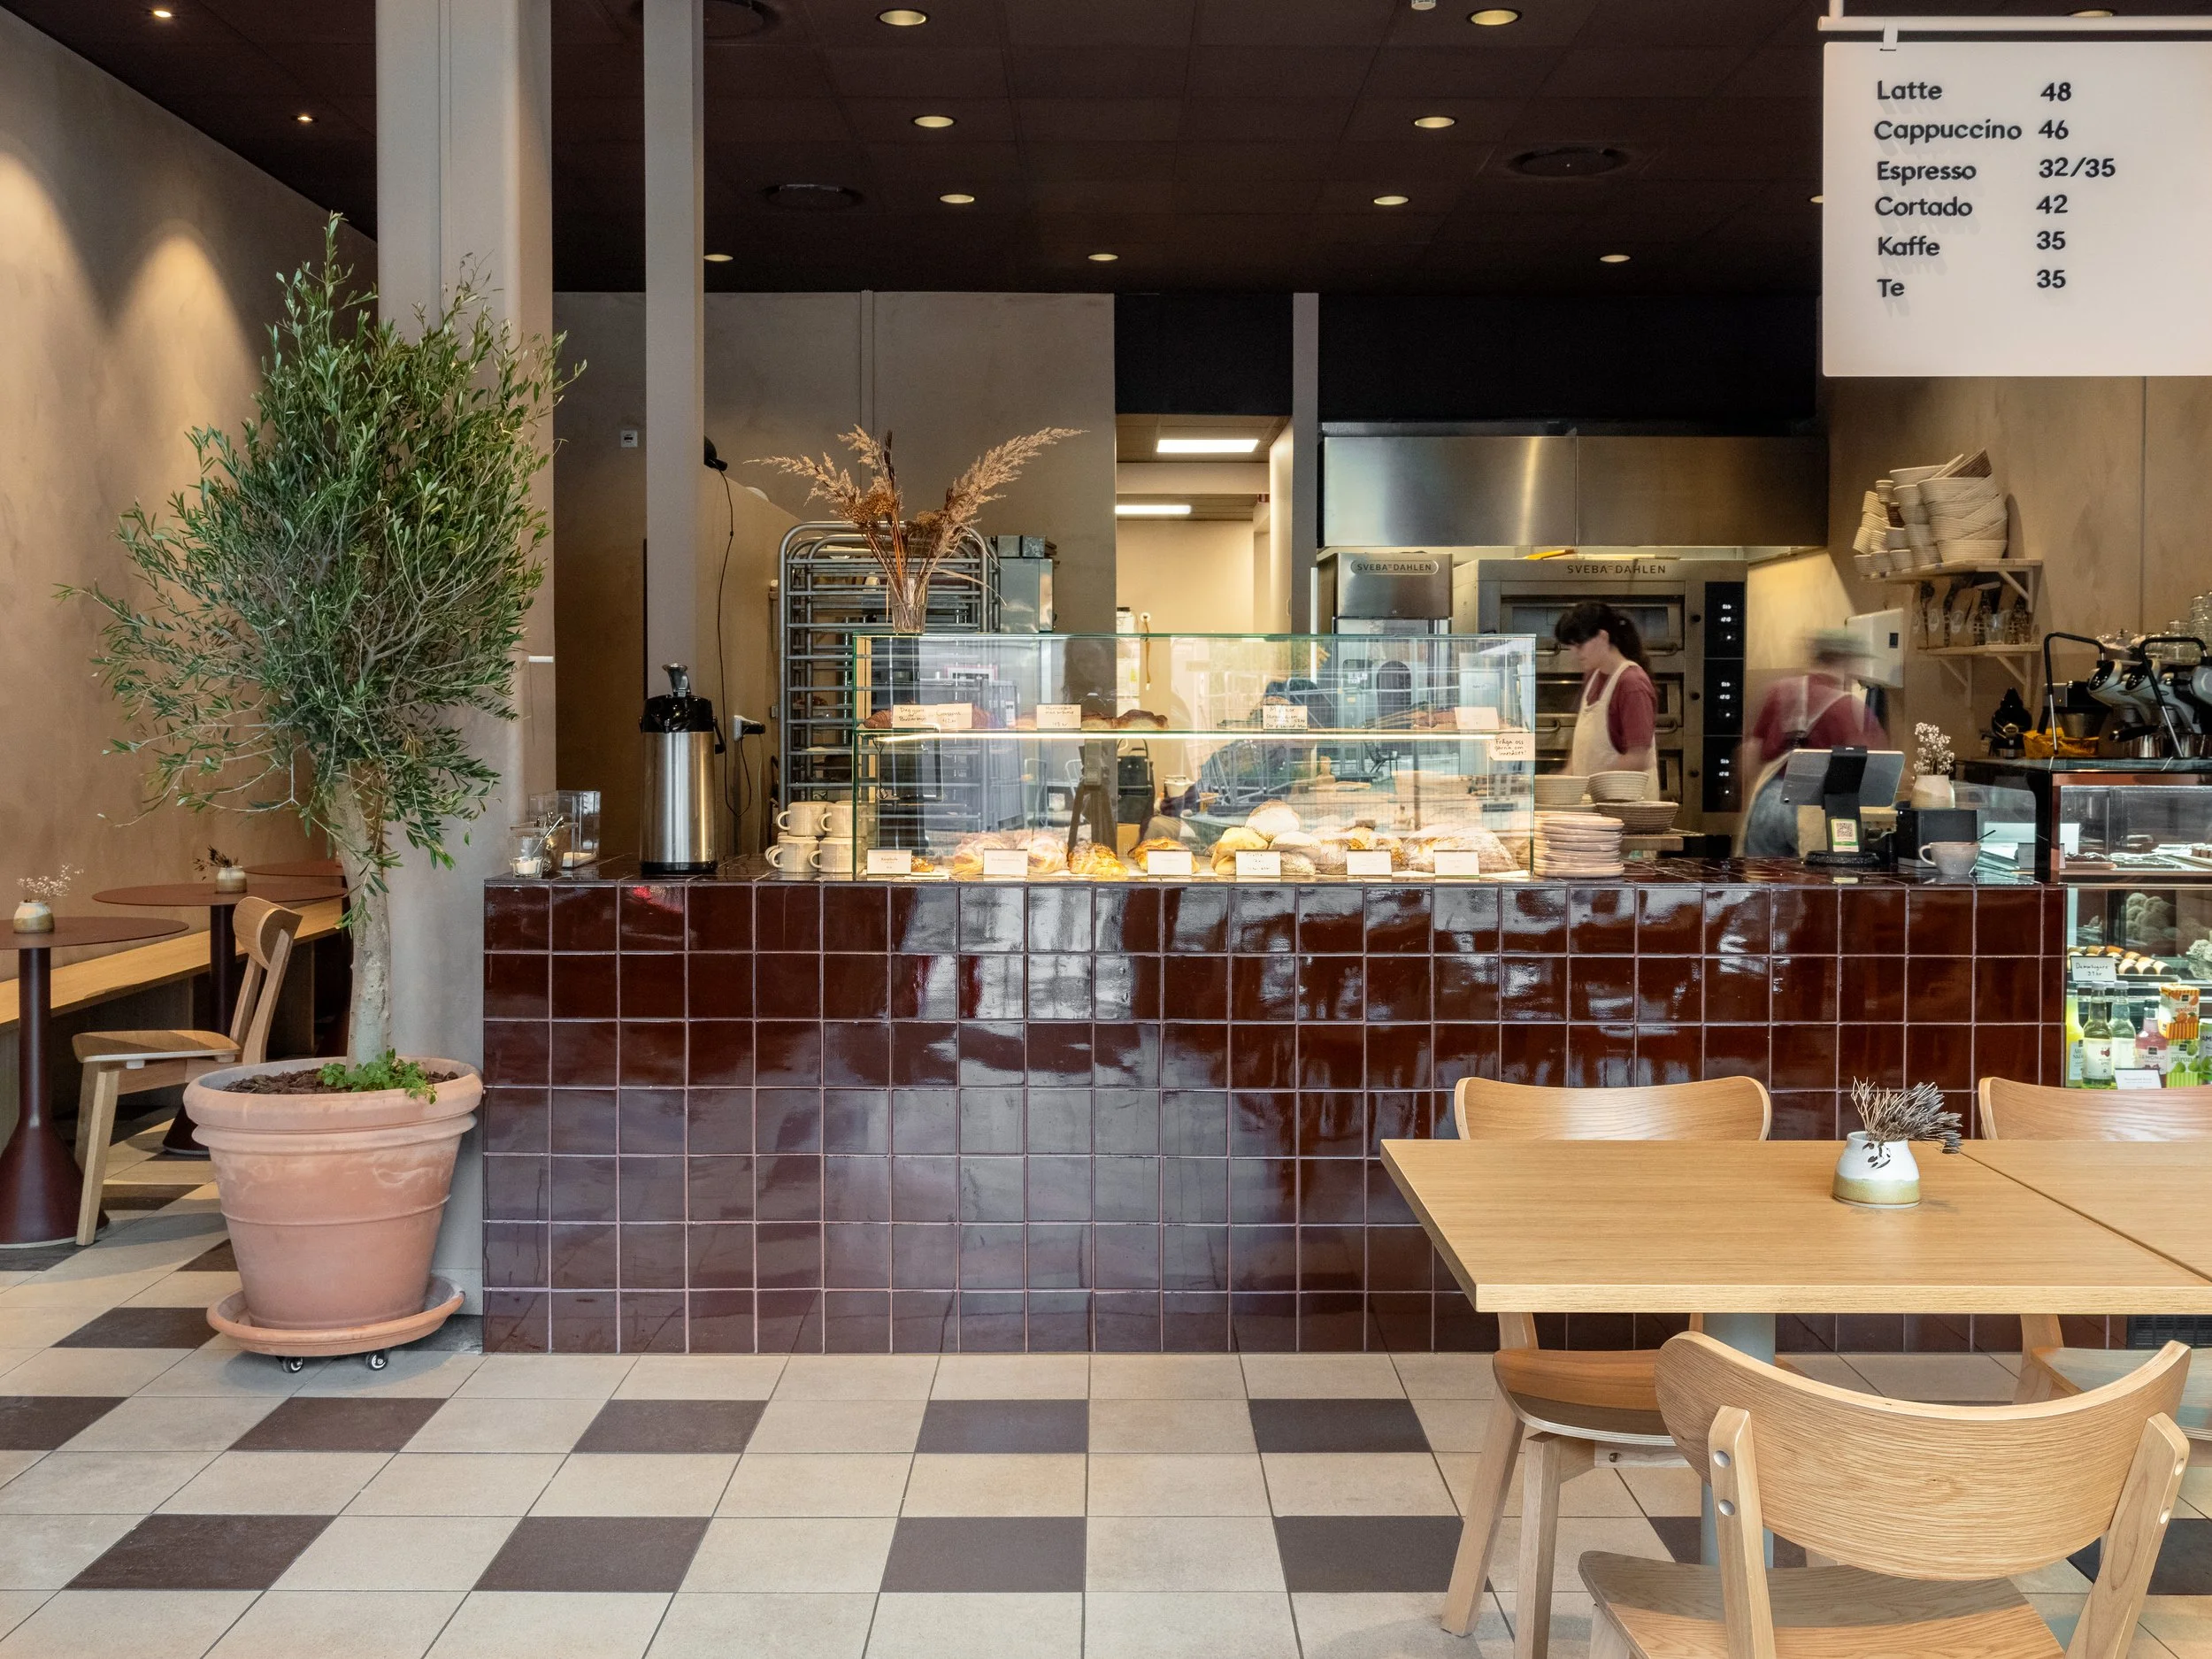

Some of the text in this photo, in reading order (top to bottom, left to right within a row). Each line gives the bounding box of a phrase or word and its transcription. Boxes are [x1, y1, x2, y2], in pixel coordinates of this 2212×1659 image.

[1878, 81, 2072, 102] Latte 48
[1874, 119, 2069, 145] Cappuccino 46
[1877, 157, 2116, 186] Espresso 32/35
[1875, 195, 2069, 217] Cortado 42
[1878, 231, 2066, 256] Kaffe 35
[1877, 270, 2066, 297] Te 35
